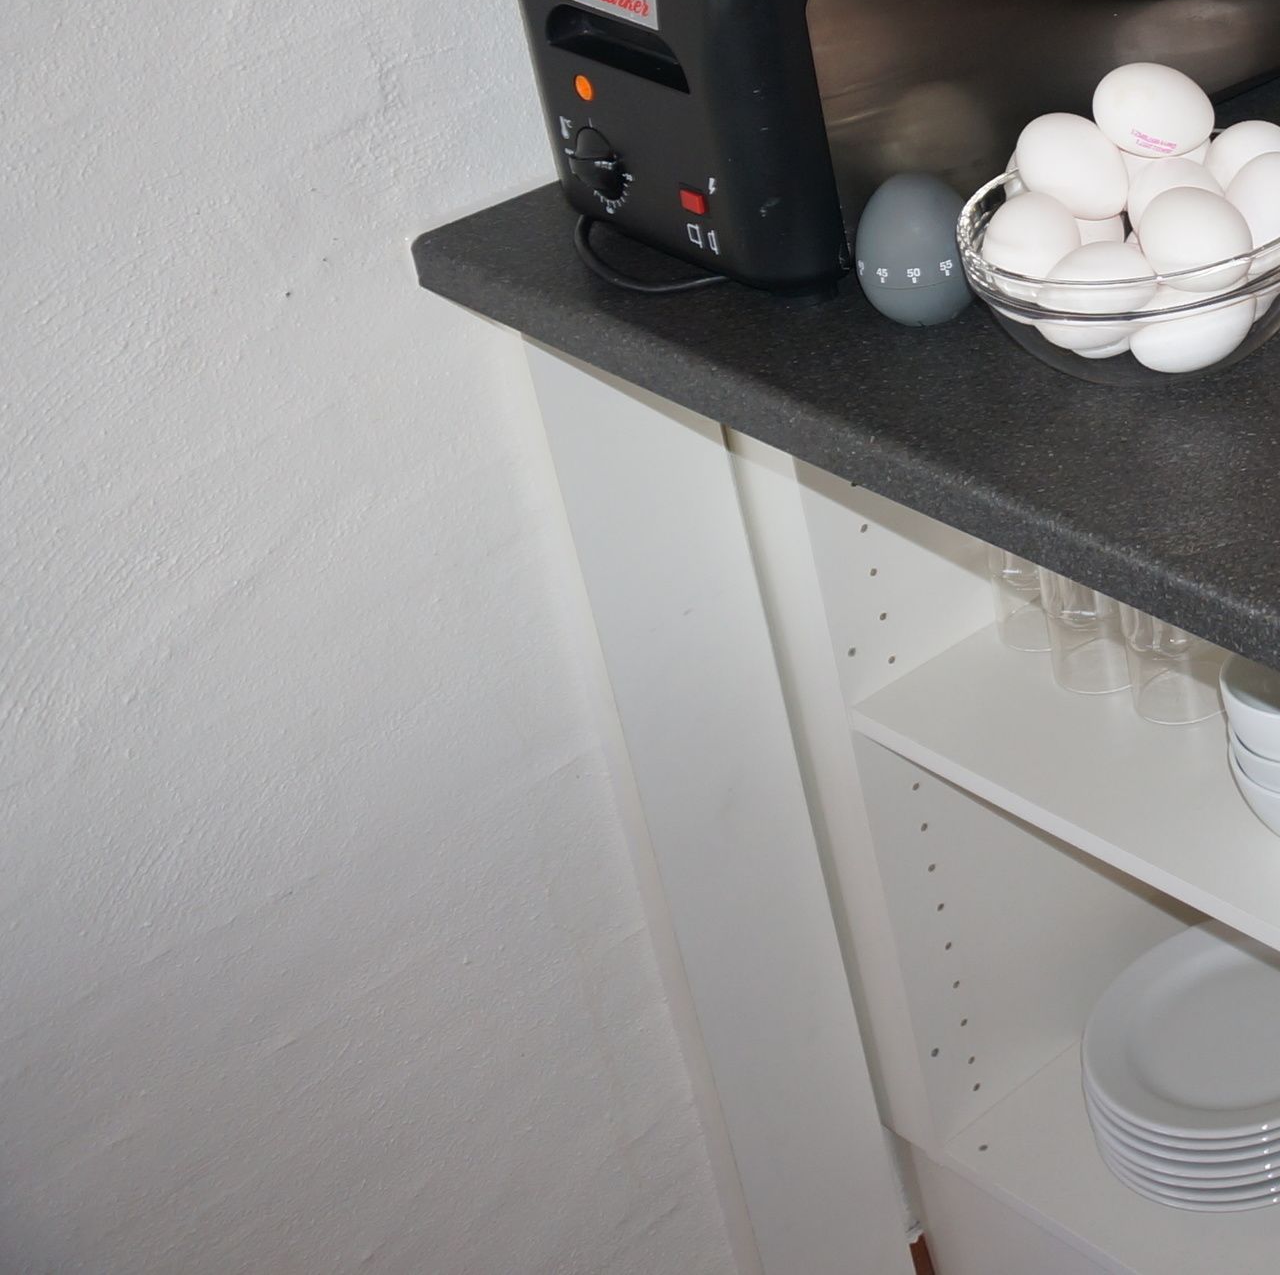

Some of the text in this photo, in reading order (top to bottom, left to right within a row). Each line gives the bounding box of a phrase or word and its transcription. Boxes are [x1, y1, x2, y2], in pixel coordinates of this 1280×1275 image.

[876, 267, 889, 277] 45
[906, 267, 921, 277] 50
[939, 259, 953, 271] 55
